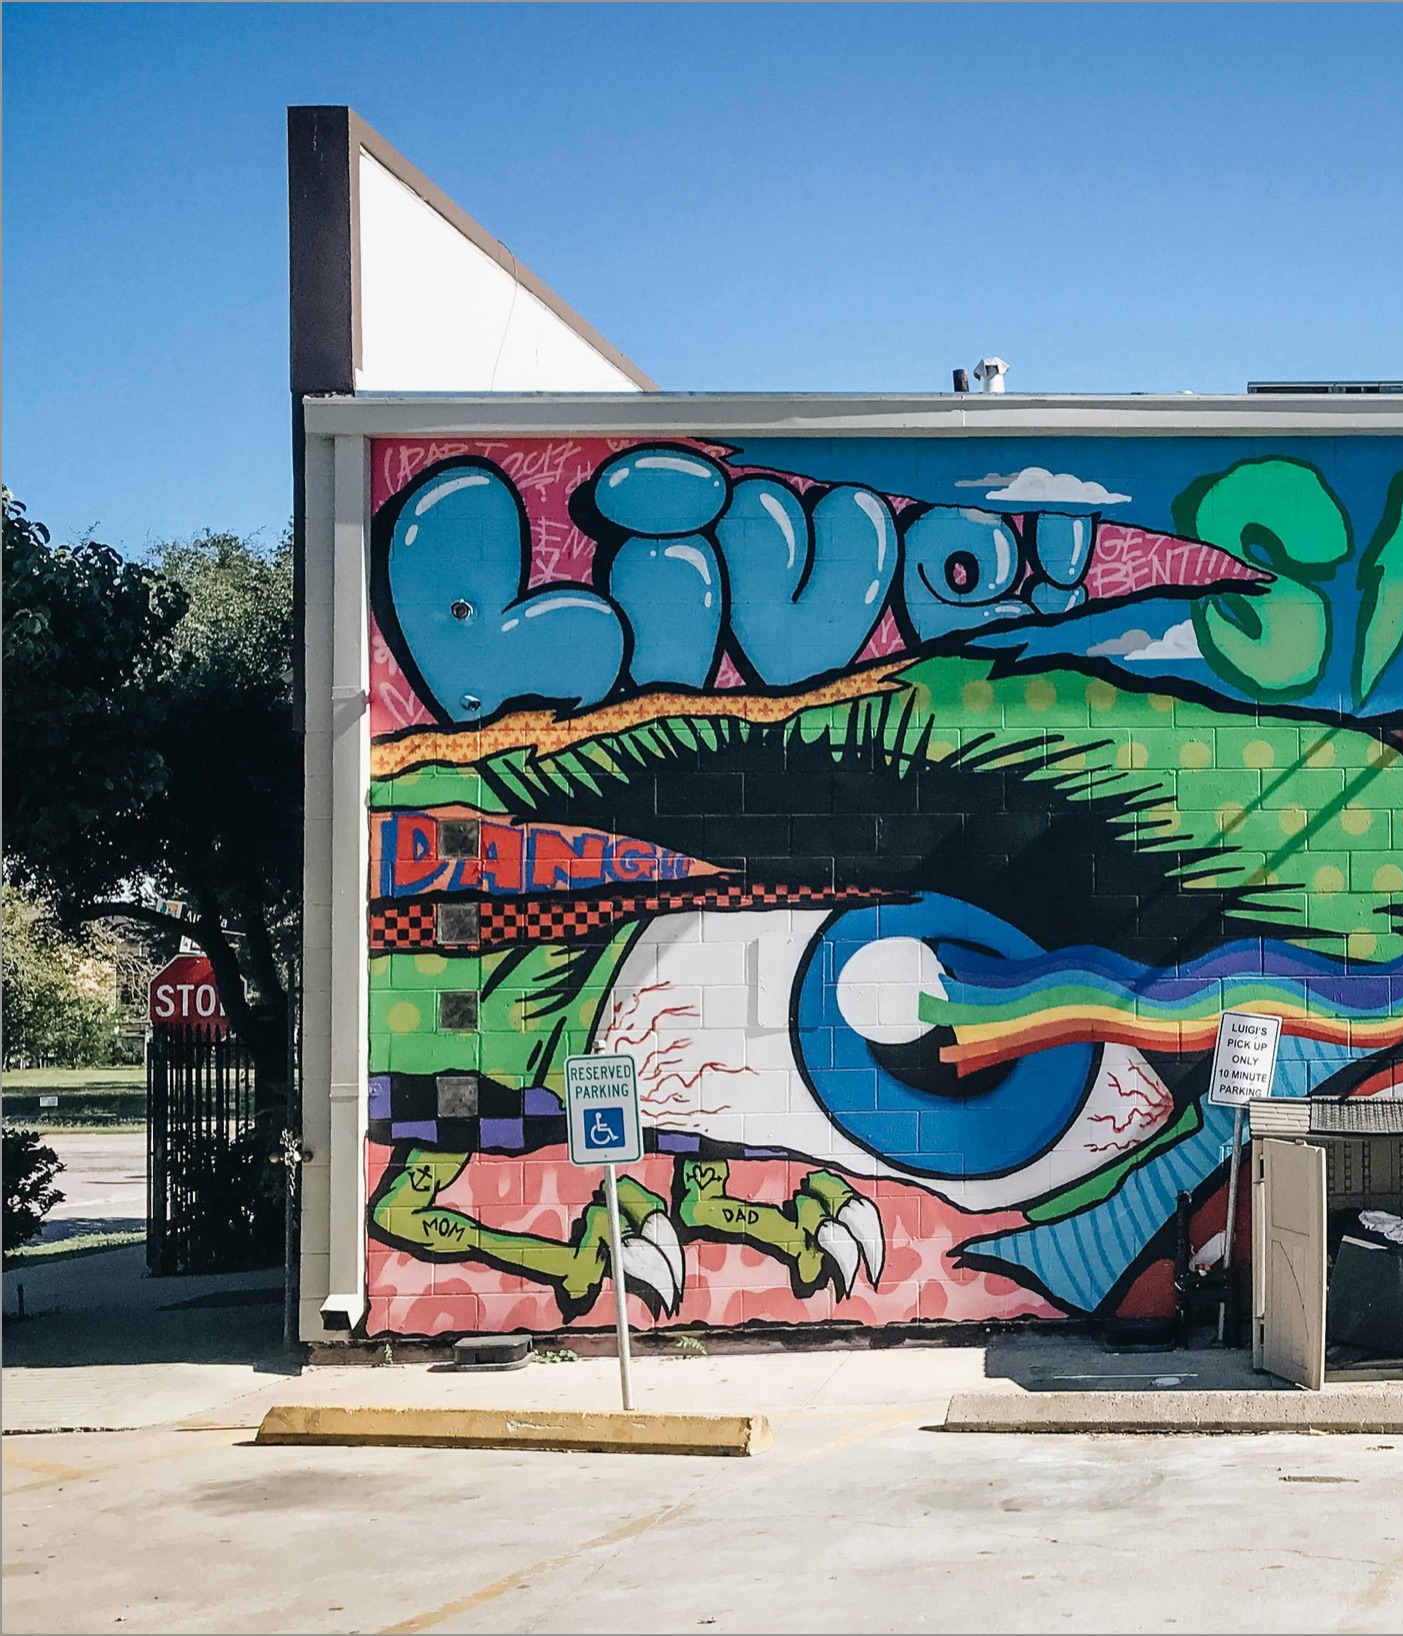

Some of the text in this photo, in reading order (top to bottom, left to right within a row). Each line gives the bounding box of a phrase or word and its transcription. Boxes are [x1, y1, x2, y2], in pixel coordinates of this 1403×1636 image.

[1097, 525, 1163, 561] GET
[155, 984, 226, 1018] STO
[1231, 1023, 1267, 1036] LUIGI'S
[1227, 1038, 1268, 1051] PICK UP
[1231, 1054, 1259, 1065] ONLY
[570, 1065, 631, 1081] RESERVED
[1219, 1069, 1267, 1082] 10 MINUTE
[575, 1083, 629, 1099] PARKING
[1219, 1084, 1262, 1097] PARKING
[722, 1208, 760, 1225] DAD
[423, 1219, 465, 1242] MOM
